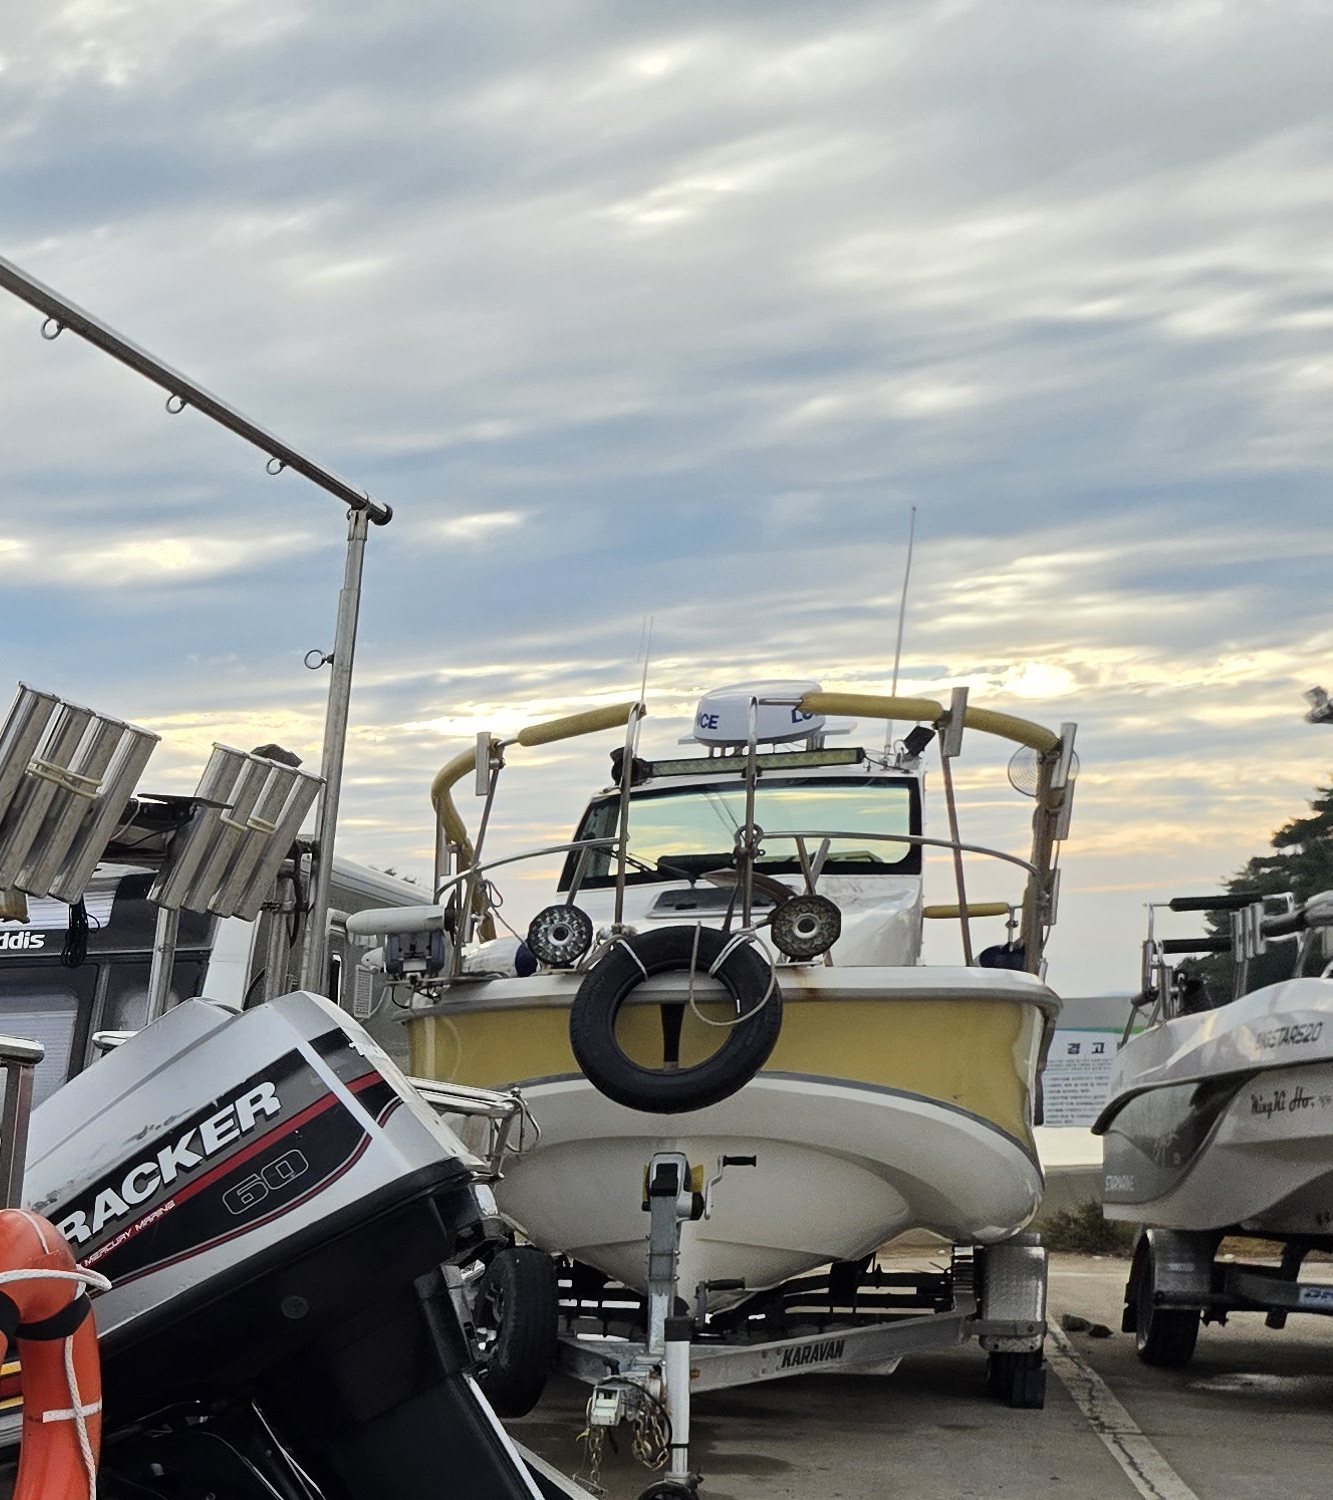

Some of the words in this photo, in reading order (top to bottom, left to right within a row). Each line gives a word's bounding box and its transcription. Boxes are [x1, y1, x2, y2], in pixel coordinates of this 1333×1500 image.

[56, 1081, 282, 1244] RACKER
[84, 1228, 132, 1267] MERCURY
[134, 1199, 177, 1232] MARINE
[781, 1339, 845, 1368] KARAVAN
